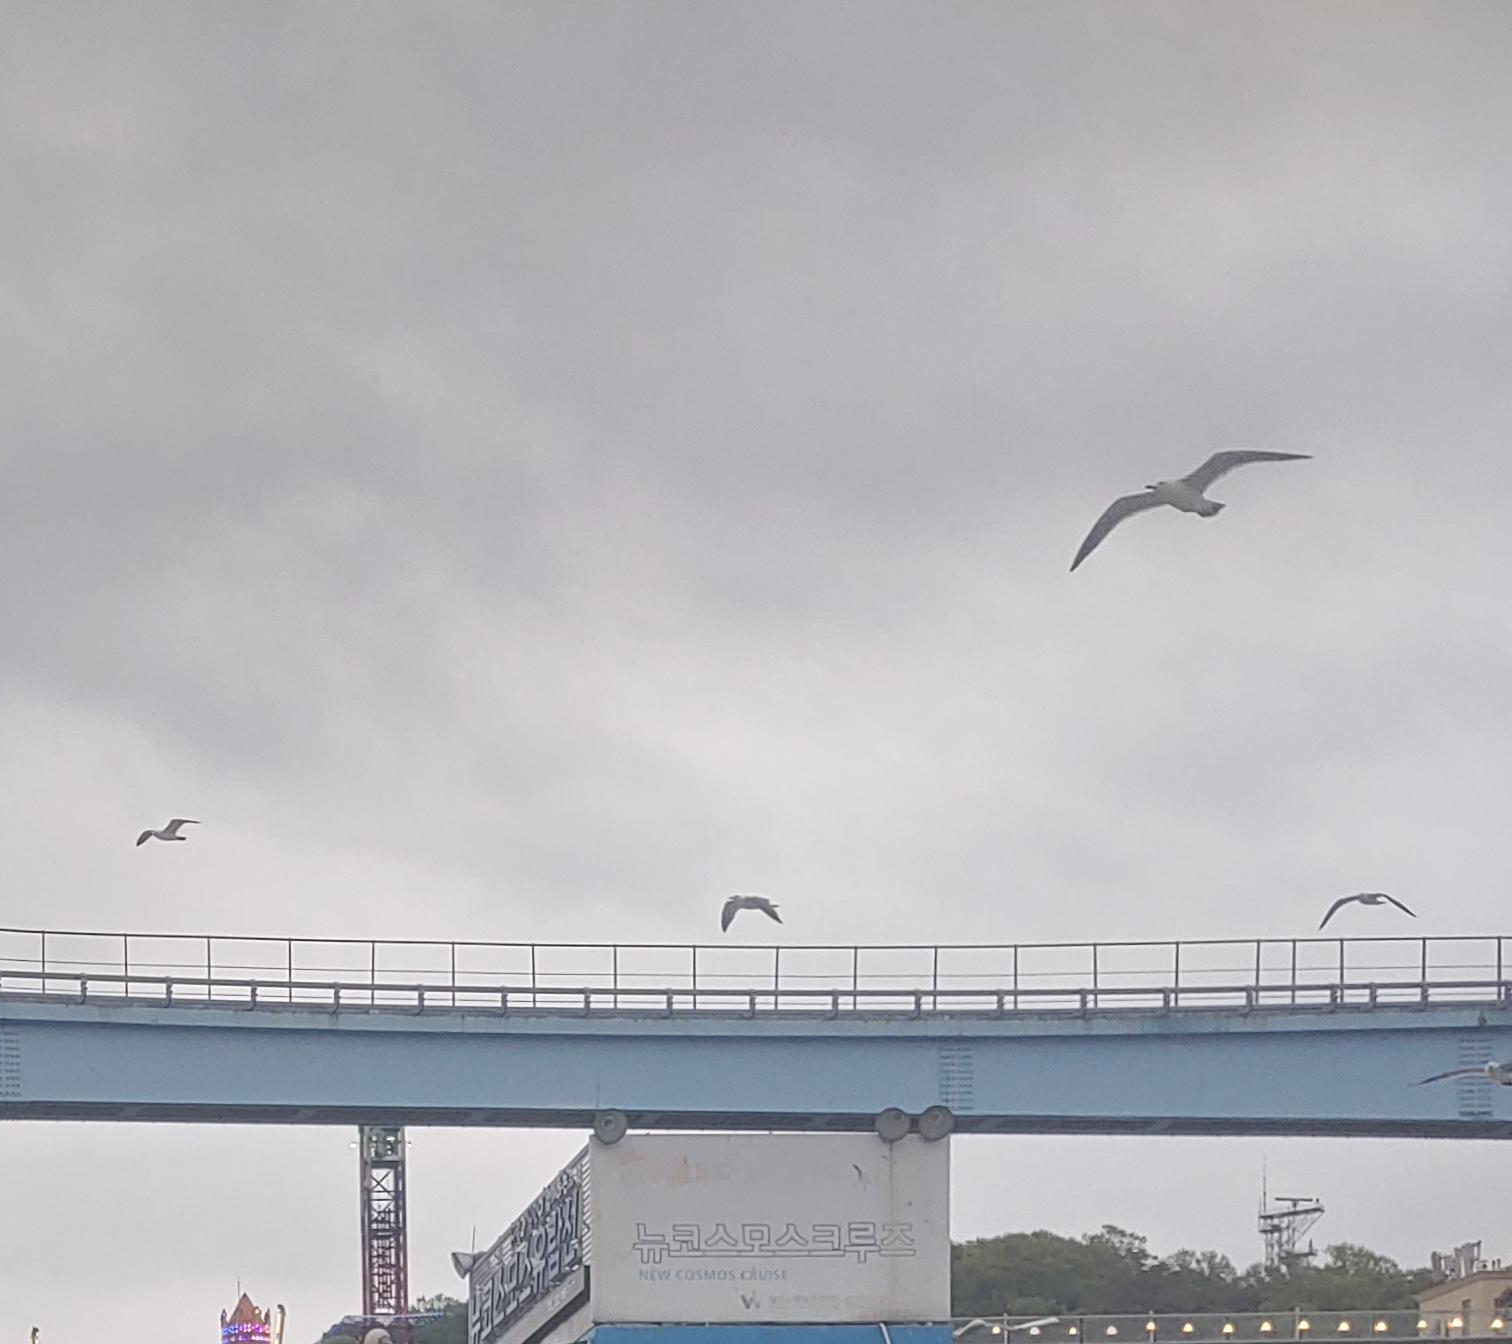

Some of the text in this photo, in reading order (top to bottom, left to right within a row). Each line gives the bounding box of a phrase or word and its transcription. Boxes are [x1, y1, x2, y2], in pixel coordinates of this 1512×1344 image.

[633, 1222, 916, 1264] 뉴코스모스크루즈
[638, 1268, 788, 1281] NEW COSMOS CRUISE
